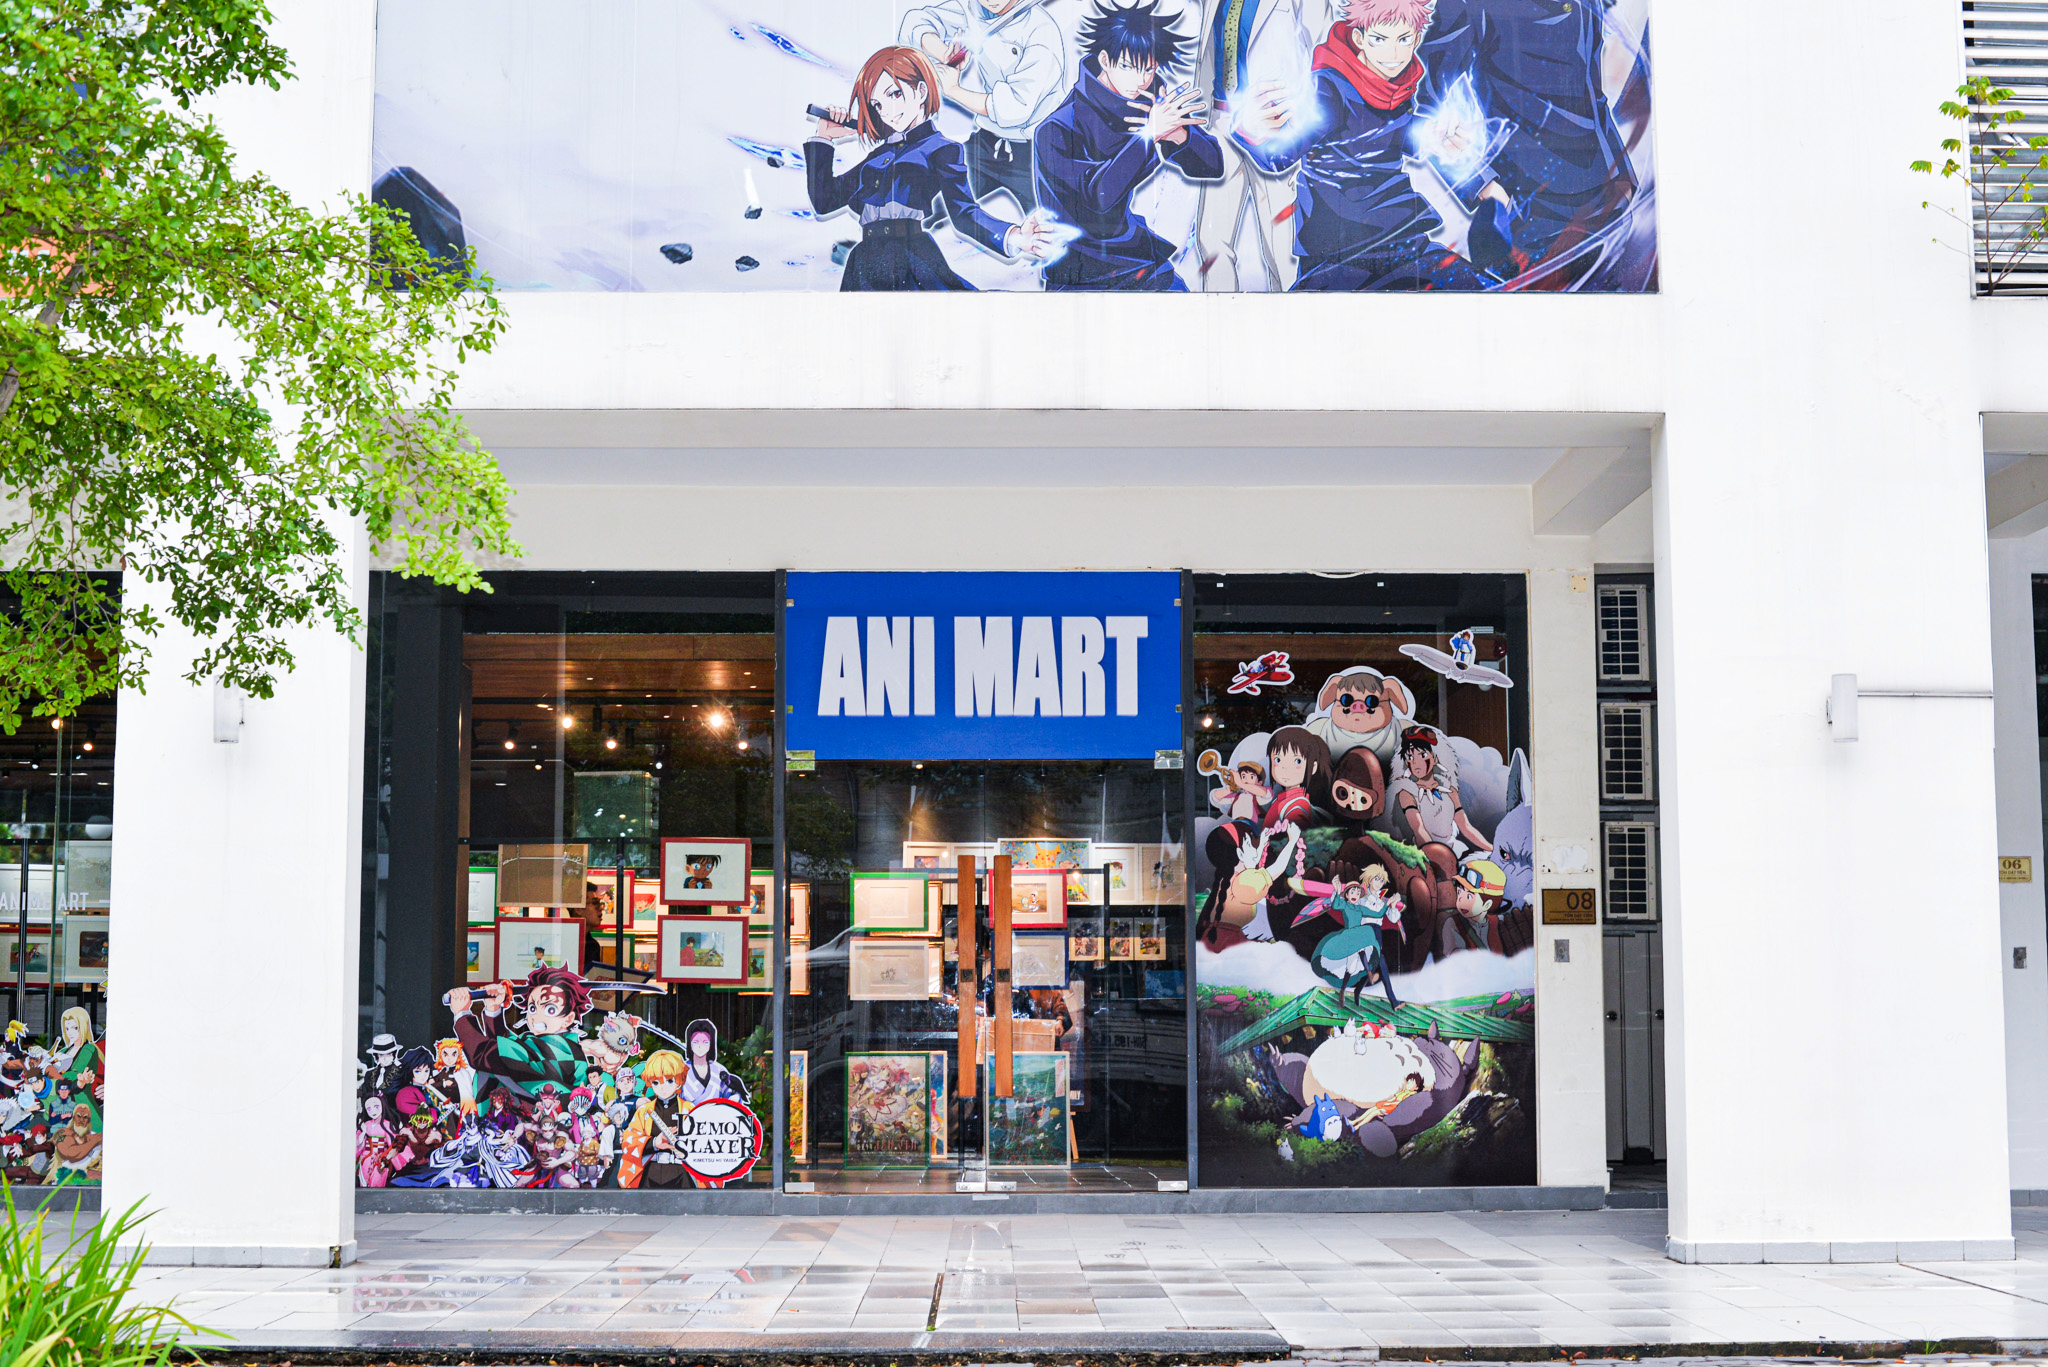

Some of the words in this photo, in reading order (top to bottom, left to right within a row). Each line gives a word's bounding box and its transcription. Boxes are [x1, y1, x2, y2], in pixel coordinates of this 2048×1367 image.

[817, 615, 936, 717] ANI
[954, 615, 1149, 717] MART
[2002, 859, 2022, 870] 06
[0, 891, 52, 911] ANIME
[57, 891, 89, 911] ART
[1566, 891, 1593, 910] 08
[676, 1113, 758, 1137] DEMON
[674, 1136, 760, 1161] SLAYER
